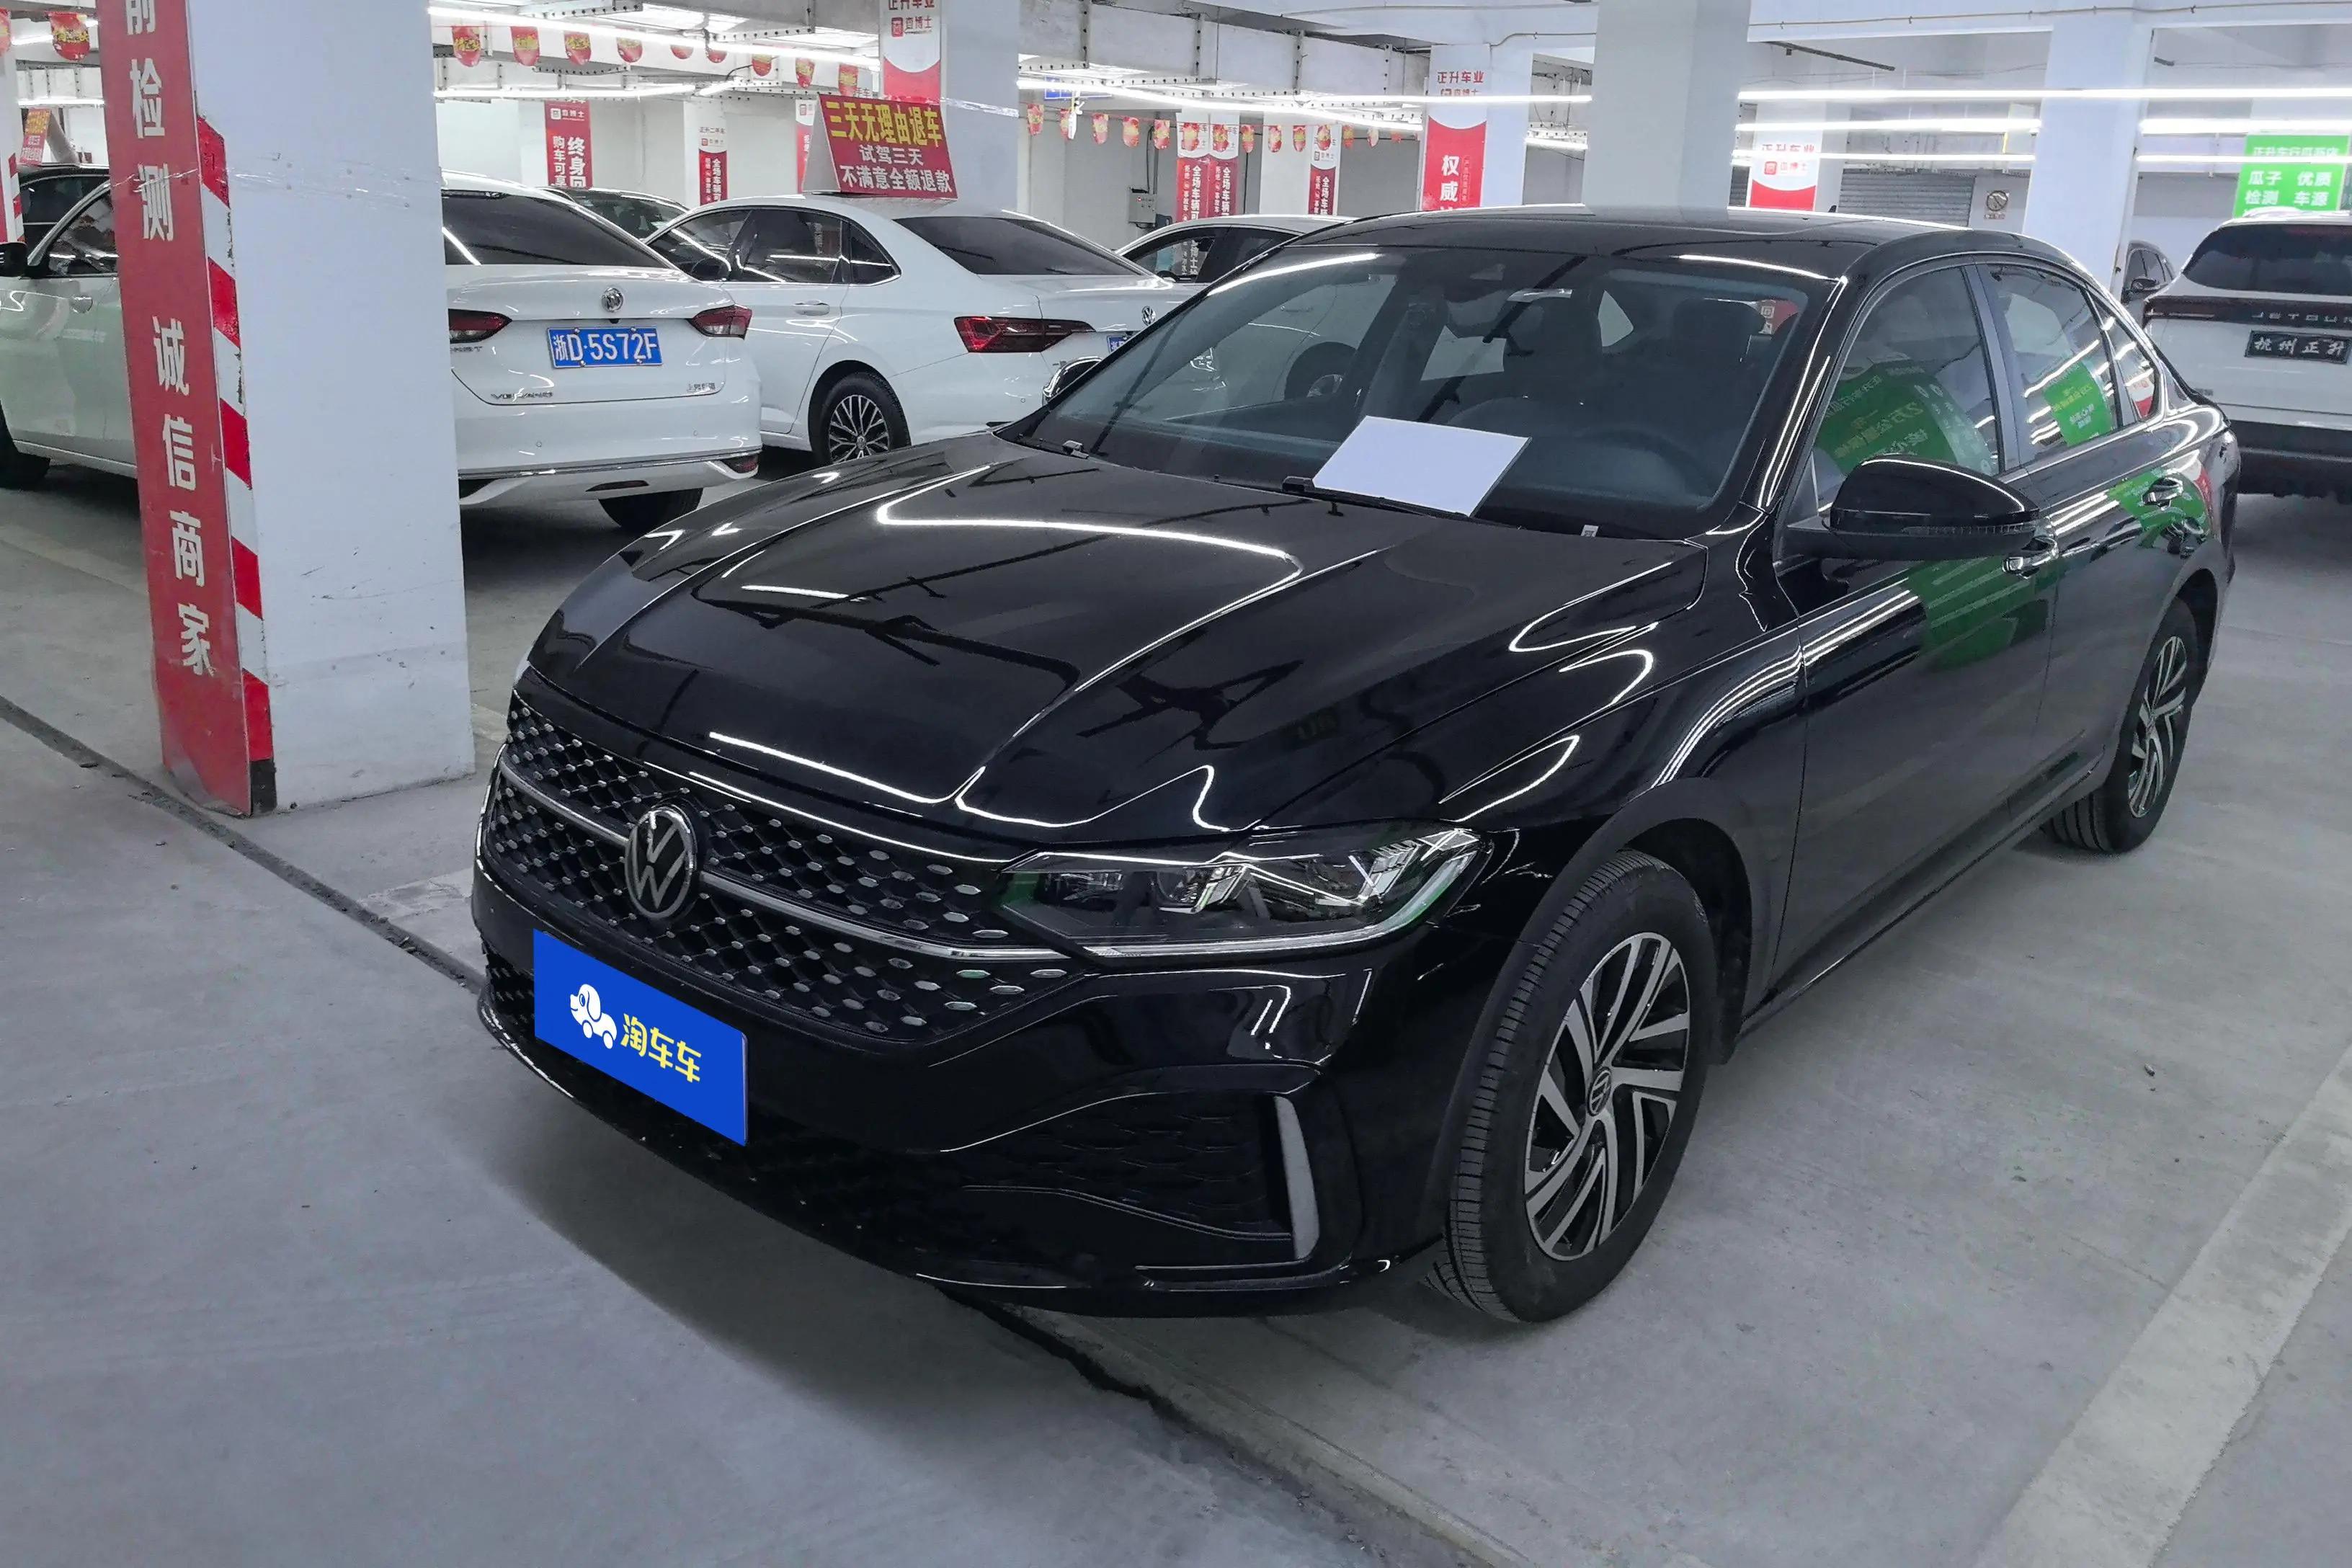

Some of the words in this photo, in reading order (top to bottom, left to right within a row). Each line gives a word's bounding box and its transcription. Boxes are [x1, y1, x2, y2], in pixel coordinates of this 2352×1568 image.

[1437, 71, 1484, 84] 正升车业
[826, 102, 942, 147] 三天无理由退车
[553, 136, 566, 187] 购车可享
[568, 137, 586, 187] 终身回
[859, 145, 924, 166] 试驾三天
[839, 166, 952, 192] 不满意全额退款
[1221, 166, 1231, 215] 全场车辆
[1440, 155, 1461, 210] 权威
[2248, 171, 2282, 186] 瓜子
[2297, 171, 2333, 187] 优质
[2245, 190, 2279, 205] 检测
[2294, 192, 2330, 206] 车源
[2254, 337, 2345, 357] 杭州正升
[152, 316, 215, 677] 诚信商家
